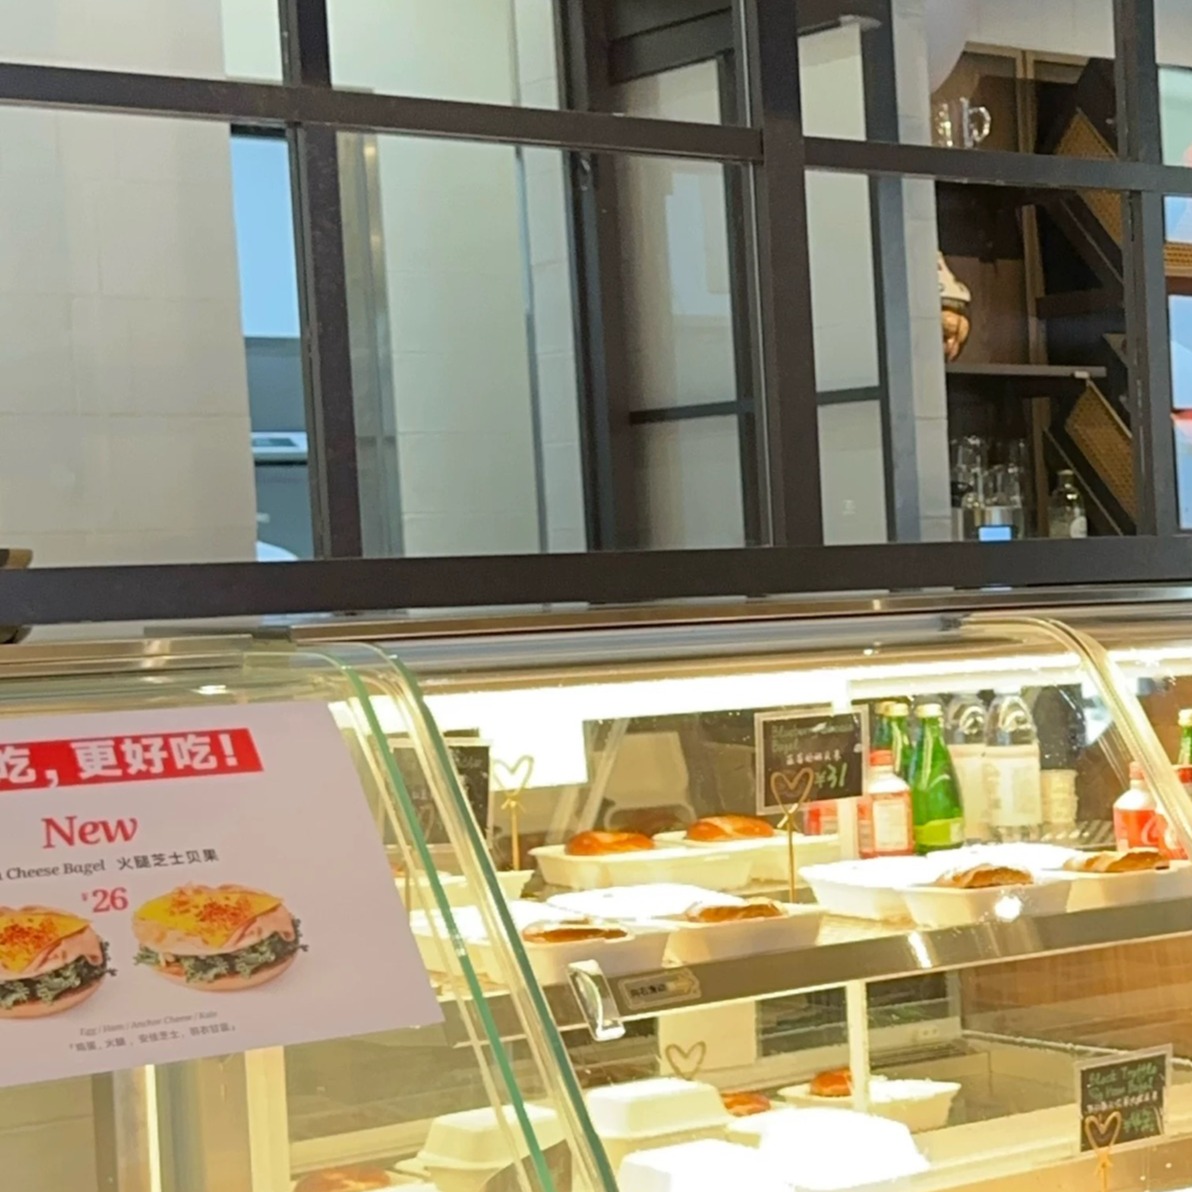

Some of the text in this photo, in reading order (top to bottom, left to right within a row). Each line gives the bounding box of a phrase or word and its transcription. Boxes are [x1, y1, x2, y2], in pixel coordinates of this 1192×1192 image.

[41, 815, 138, 849] New
[6, 866, 60, 880] Cheese
[63, 859, 106, 876] Bagel
[116, 848, 220, 871] 火腿芝士贝果
